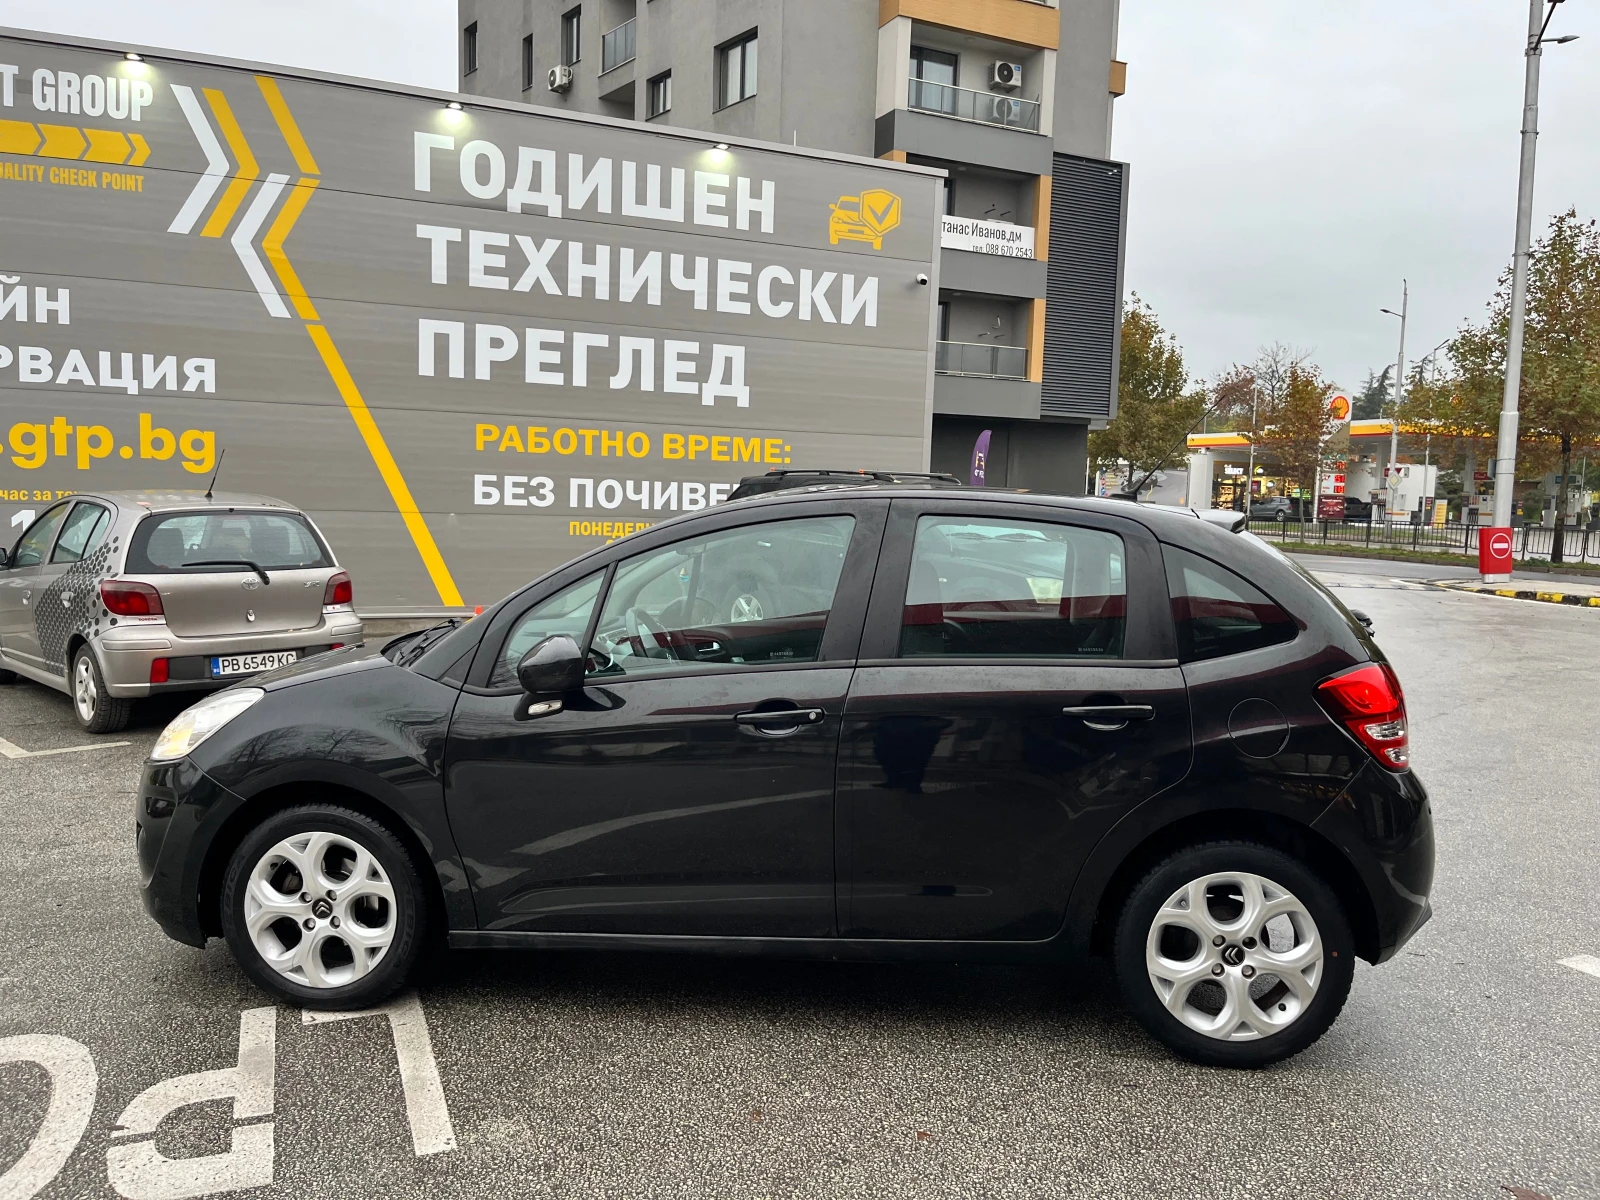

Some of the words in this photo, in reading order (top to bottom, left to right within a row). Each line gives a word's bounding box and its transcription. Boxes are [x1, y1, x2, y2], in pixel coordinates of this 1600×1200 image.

[32, 68, 154, 121] GROUP
[49, 166, 98, 188] CHECK
[102, 171, 145, 192] POINT
[413, 132, 776, 235] ГОДИШЕН
[416, 223, 879, 328] ТЕХНИЧЕСКИ
[418, 318, 751, 408] ПРЕГЛЕД
[0, 412, 217, 475] gtp.bg
[475, 423, 651, 459] РАБОТНО
[662, 433, 792, 464] ВРЕМЕ:
[33, 489, 52, 501] за
[474, 474, 555, 507] БЕЗ
[569, 477, 741, 511] ПОЧИВЕ
[221, 659, 240, 672] PB
[243, 655, 275, 670] 6549
